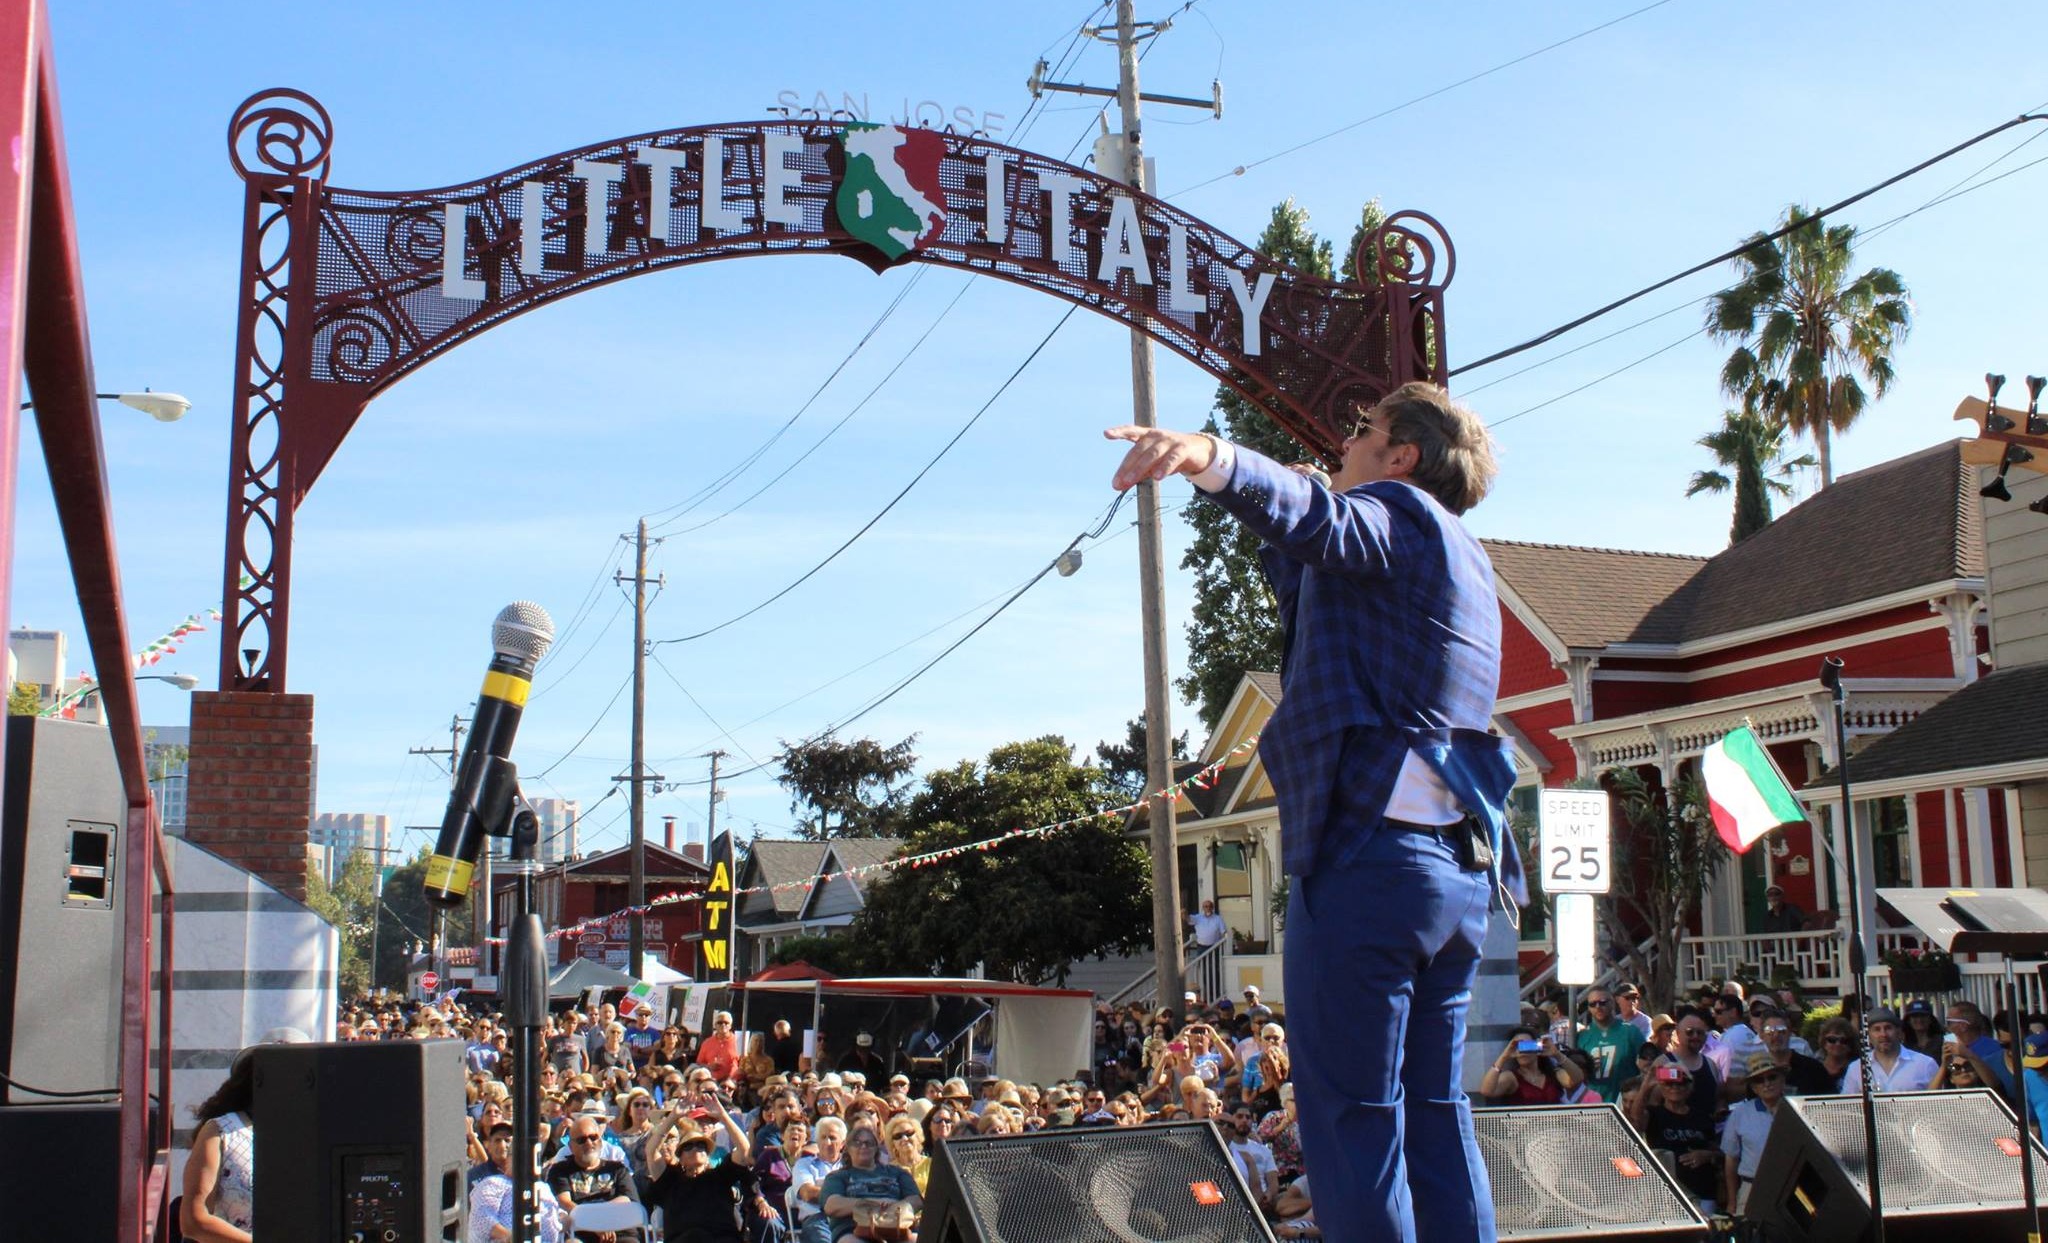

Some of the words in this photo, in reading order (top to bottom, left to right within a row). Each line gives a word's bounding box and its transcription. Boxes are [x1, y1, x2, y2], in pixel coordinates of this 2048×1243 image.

[777, 90, 869, 122] SAN
[890, 97, 1006, 143] JOSE
[442, 132, 804, 301] LITTLE
[985, 155, 1276, 356] ITALY
[1549, 800, 1601, 816] SPEED
[1554, 823, 1595, 837] LIMIT
[1551, 846, 1600, 881] 25
[703, 861, 730, 970] ATM
